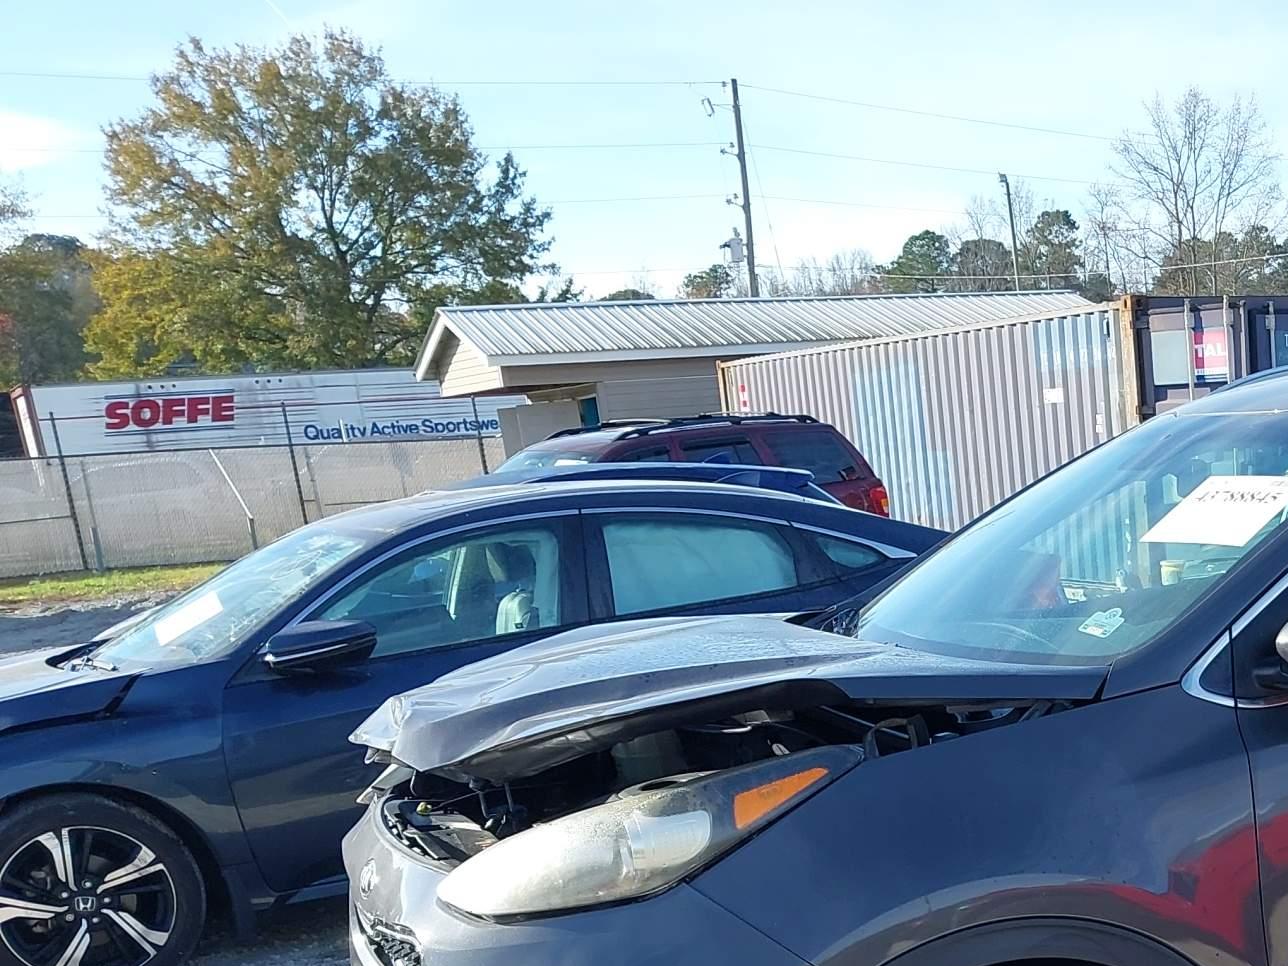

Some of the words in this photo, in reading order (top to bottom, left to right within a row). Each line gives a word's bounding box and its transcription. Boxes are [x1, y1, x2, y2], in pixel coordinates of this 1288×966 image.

[105, 395, 234, 430] SOFFE
[304, 424, 367, 441] Quaity
[370, 420, 420, 437] Active
